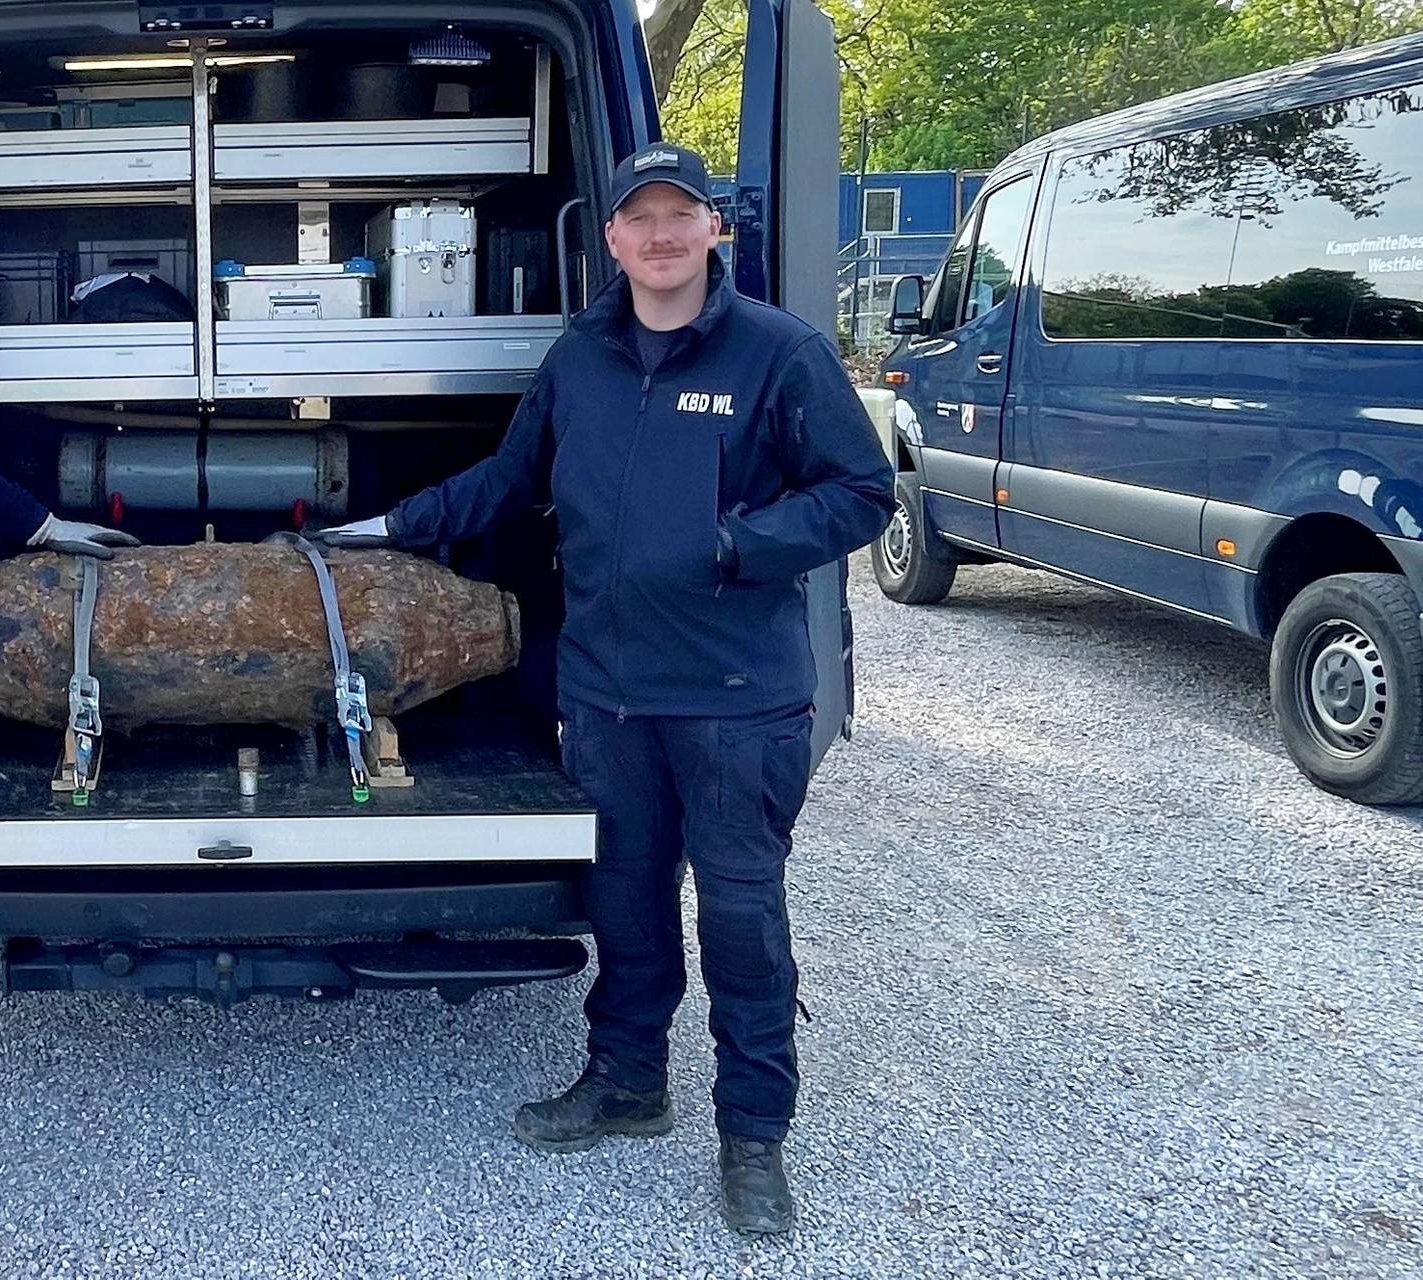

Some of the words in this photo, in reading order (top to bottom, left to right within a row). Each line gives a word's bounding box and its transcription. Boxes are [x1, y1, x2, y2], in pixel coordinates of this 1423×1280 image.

[1326, 234, 1423, 256] Kampfmittelbes
[1368, 256, 1423, 273] Westfale
[677, 392, 710, 413] KBD
[712, 394, 734, 415] WL
